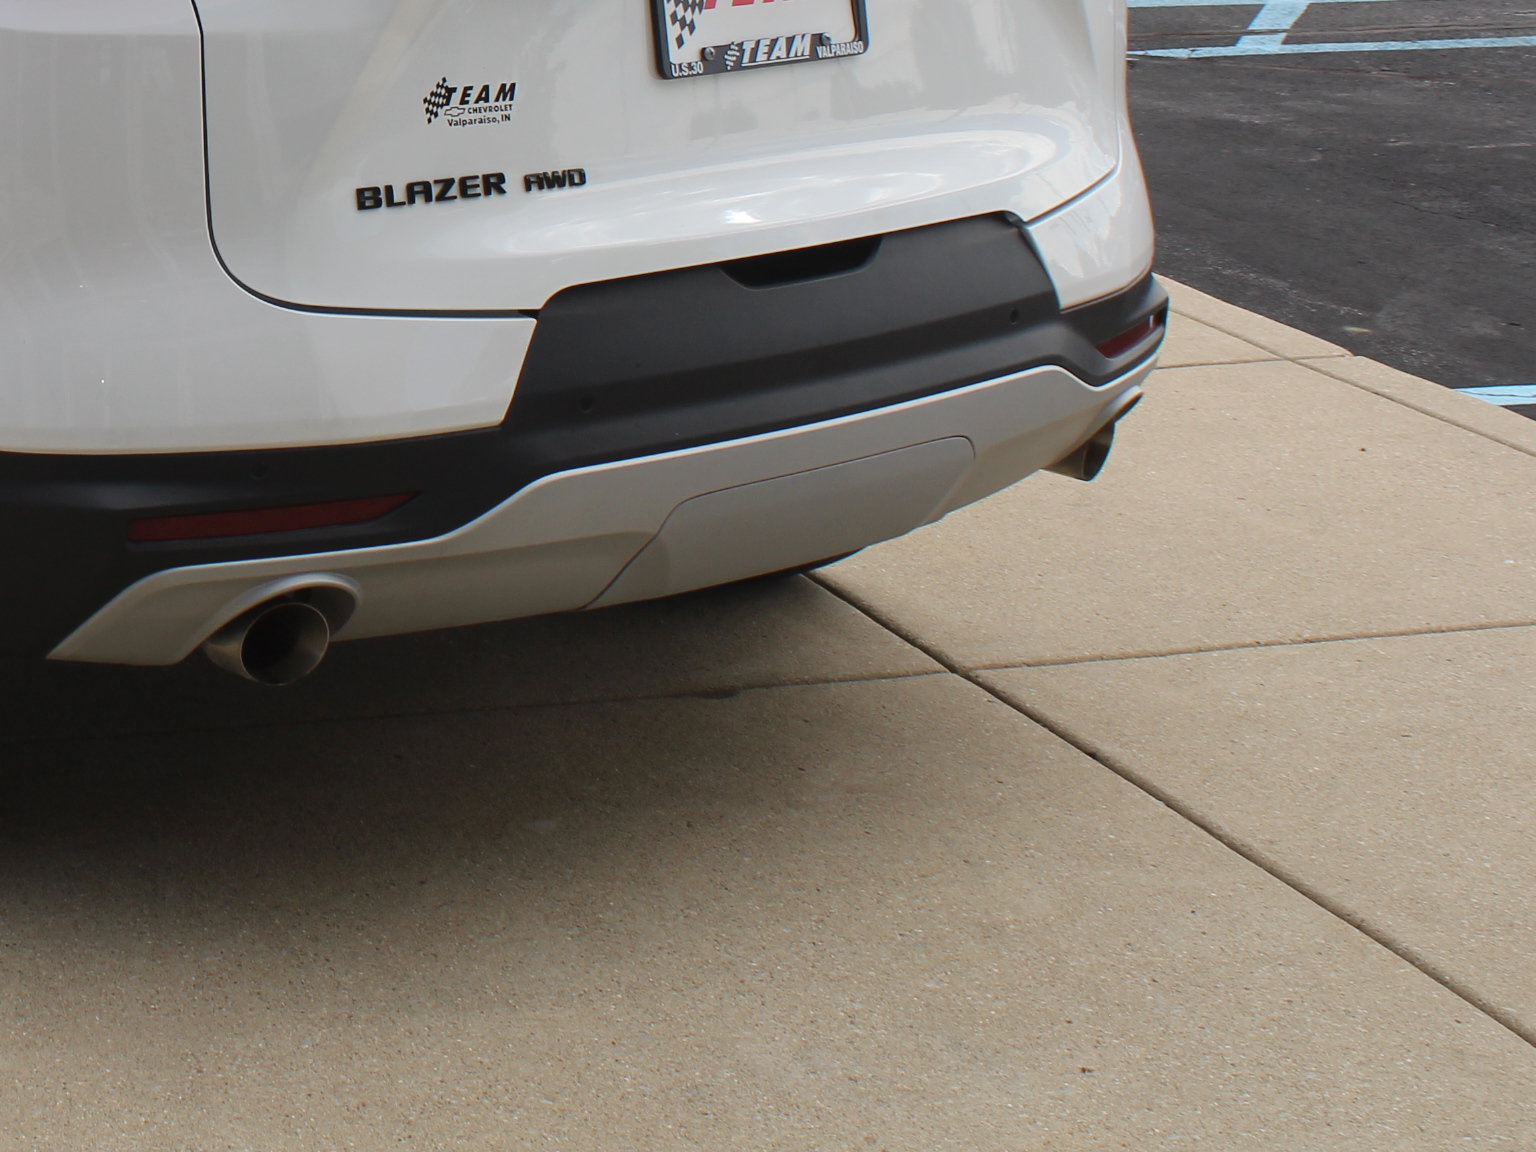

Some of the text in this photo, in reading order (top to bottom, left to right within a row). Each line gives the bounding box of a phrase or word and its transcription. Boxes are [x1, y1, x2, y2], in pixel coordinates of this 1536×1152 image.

[740, 33, 812, 65] TEAM
[816, 40, 864, 60] VALPARAISO
[442, 82, 517, 107] TEAM
[446, 113, 512, 128] Valparaiso, IN
[467, 103, 513, 115] CHEVROLET
[355, 167, 587, 212] BLAZER AWD
